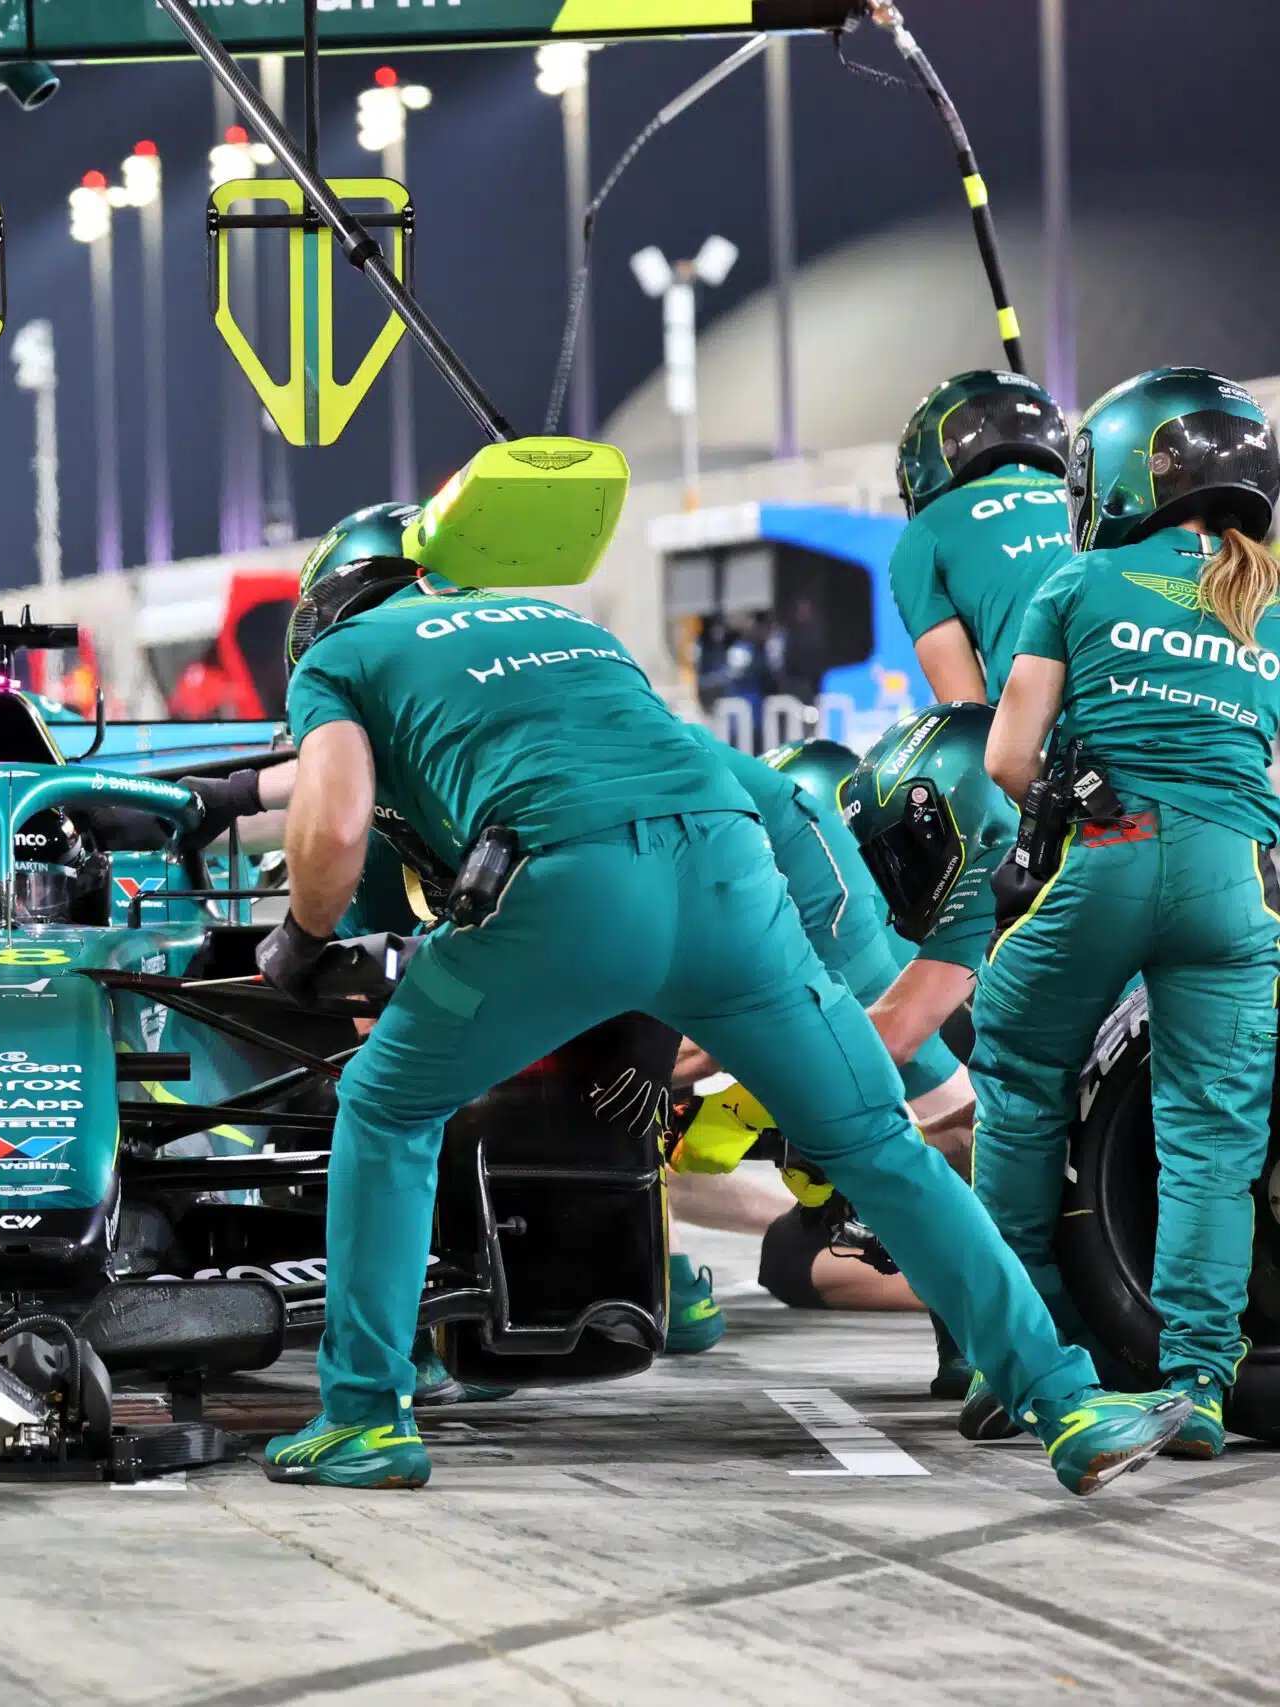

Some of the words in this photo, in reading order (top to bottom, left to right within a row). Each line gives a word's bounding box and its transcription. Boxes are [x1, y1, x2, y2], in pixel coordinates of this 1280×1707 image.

[1110, 621, 1279, 681] aramco
[1140, 680, 1258, 726] Honda
[886, 715, 941, 776] Valvoline
[932, 876, 946, 901] ASTON
[941, 855, 959, 881] MARTIN
